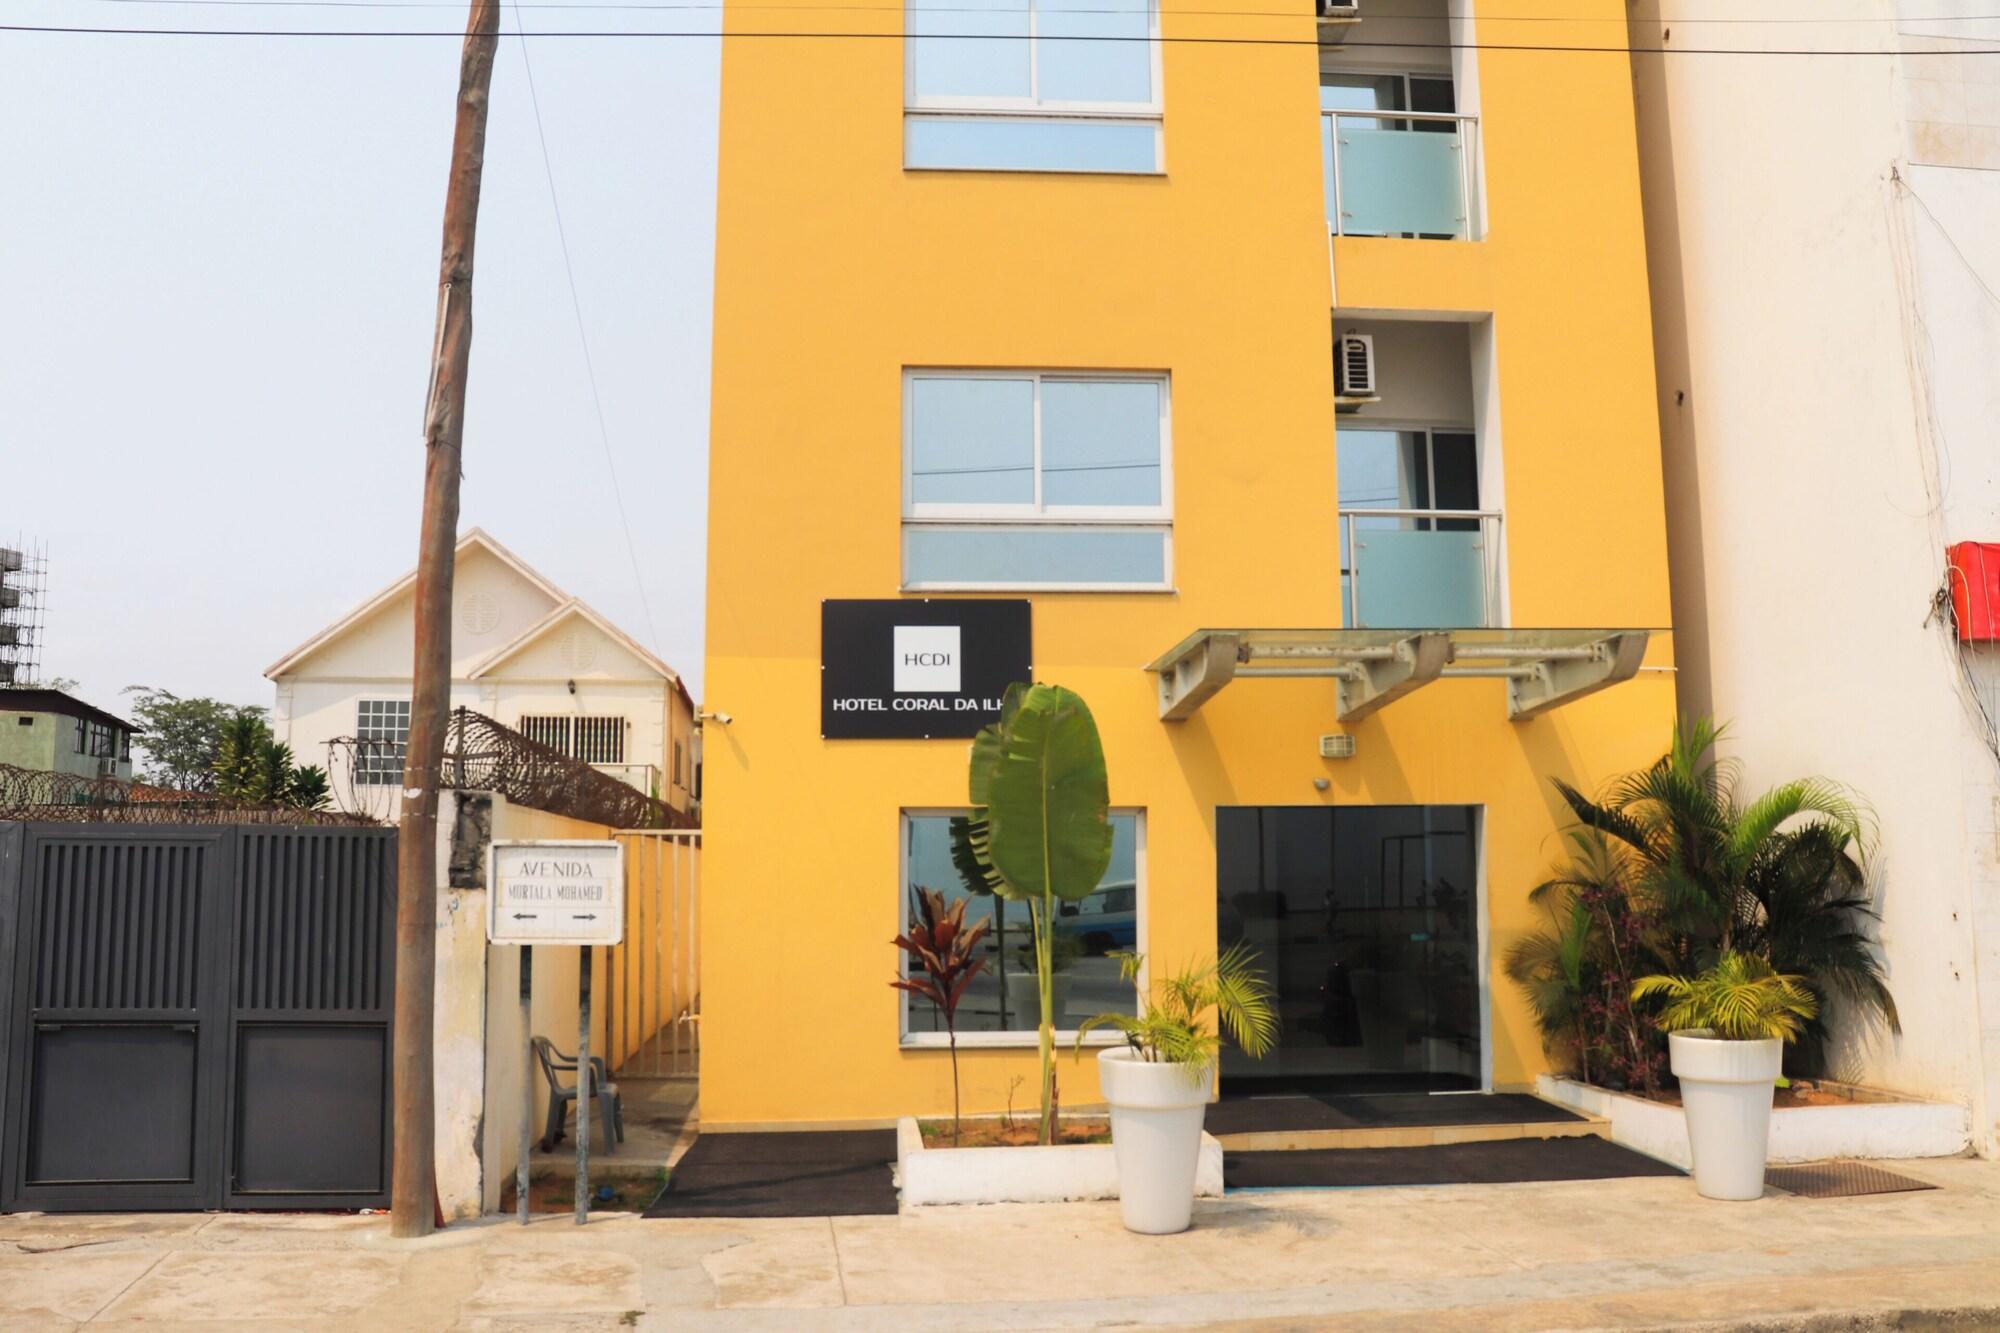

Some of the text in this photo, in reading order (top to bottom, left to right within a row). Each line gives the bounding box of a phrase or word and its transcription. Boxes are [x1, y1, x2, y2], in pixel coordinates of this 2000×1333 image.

[904, 653, 951, 667] HCDI
[833, 698, 887, 711] HOTEL
[892, 698, 949, 711] CORAL
[954, 698, 978, 711] DA
[520, 861, 593, 878] AVENIDA
[556, 885, 603, 901] MOHAMED
